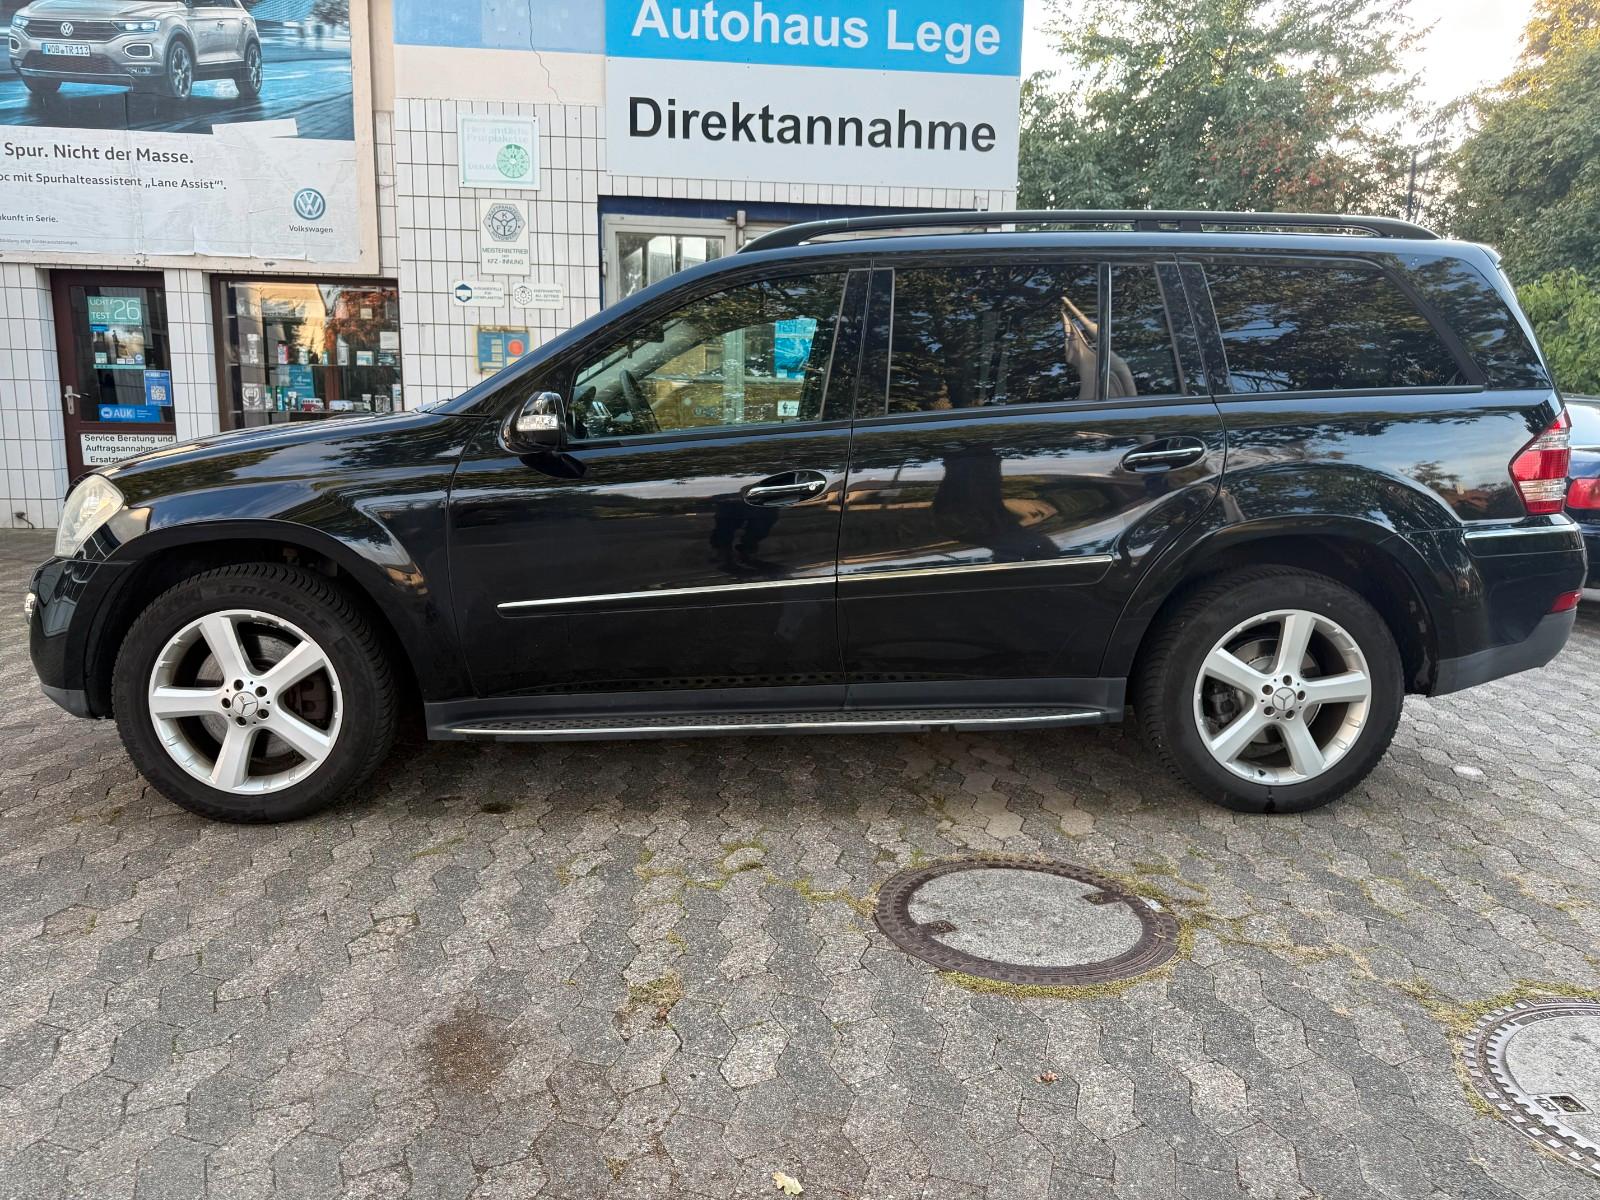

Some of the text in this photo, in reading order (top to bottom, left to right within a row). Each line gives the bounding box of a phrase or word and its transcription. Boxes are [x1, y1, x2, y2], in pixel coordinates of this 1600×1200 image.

[632, 0, 1000, 65] Autohaus Lege
[629, 96, 996, 153] Direktannahme
[4, 142, 194, 164] Spur. Nicht der Masse.
[13, 172, 33, 182] mit
[36, 173, 142, 187] Spurhalteassistent
[26, 214, 34, 222] in
[35, 214, 59, 223] Serie.
[289, 224, 334, 234] Volkswagen
[113, 407, 133, 419] AUK
[84, 434, 174, 443] Service Beratung und
